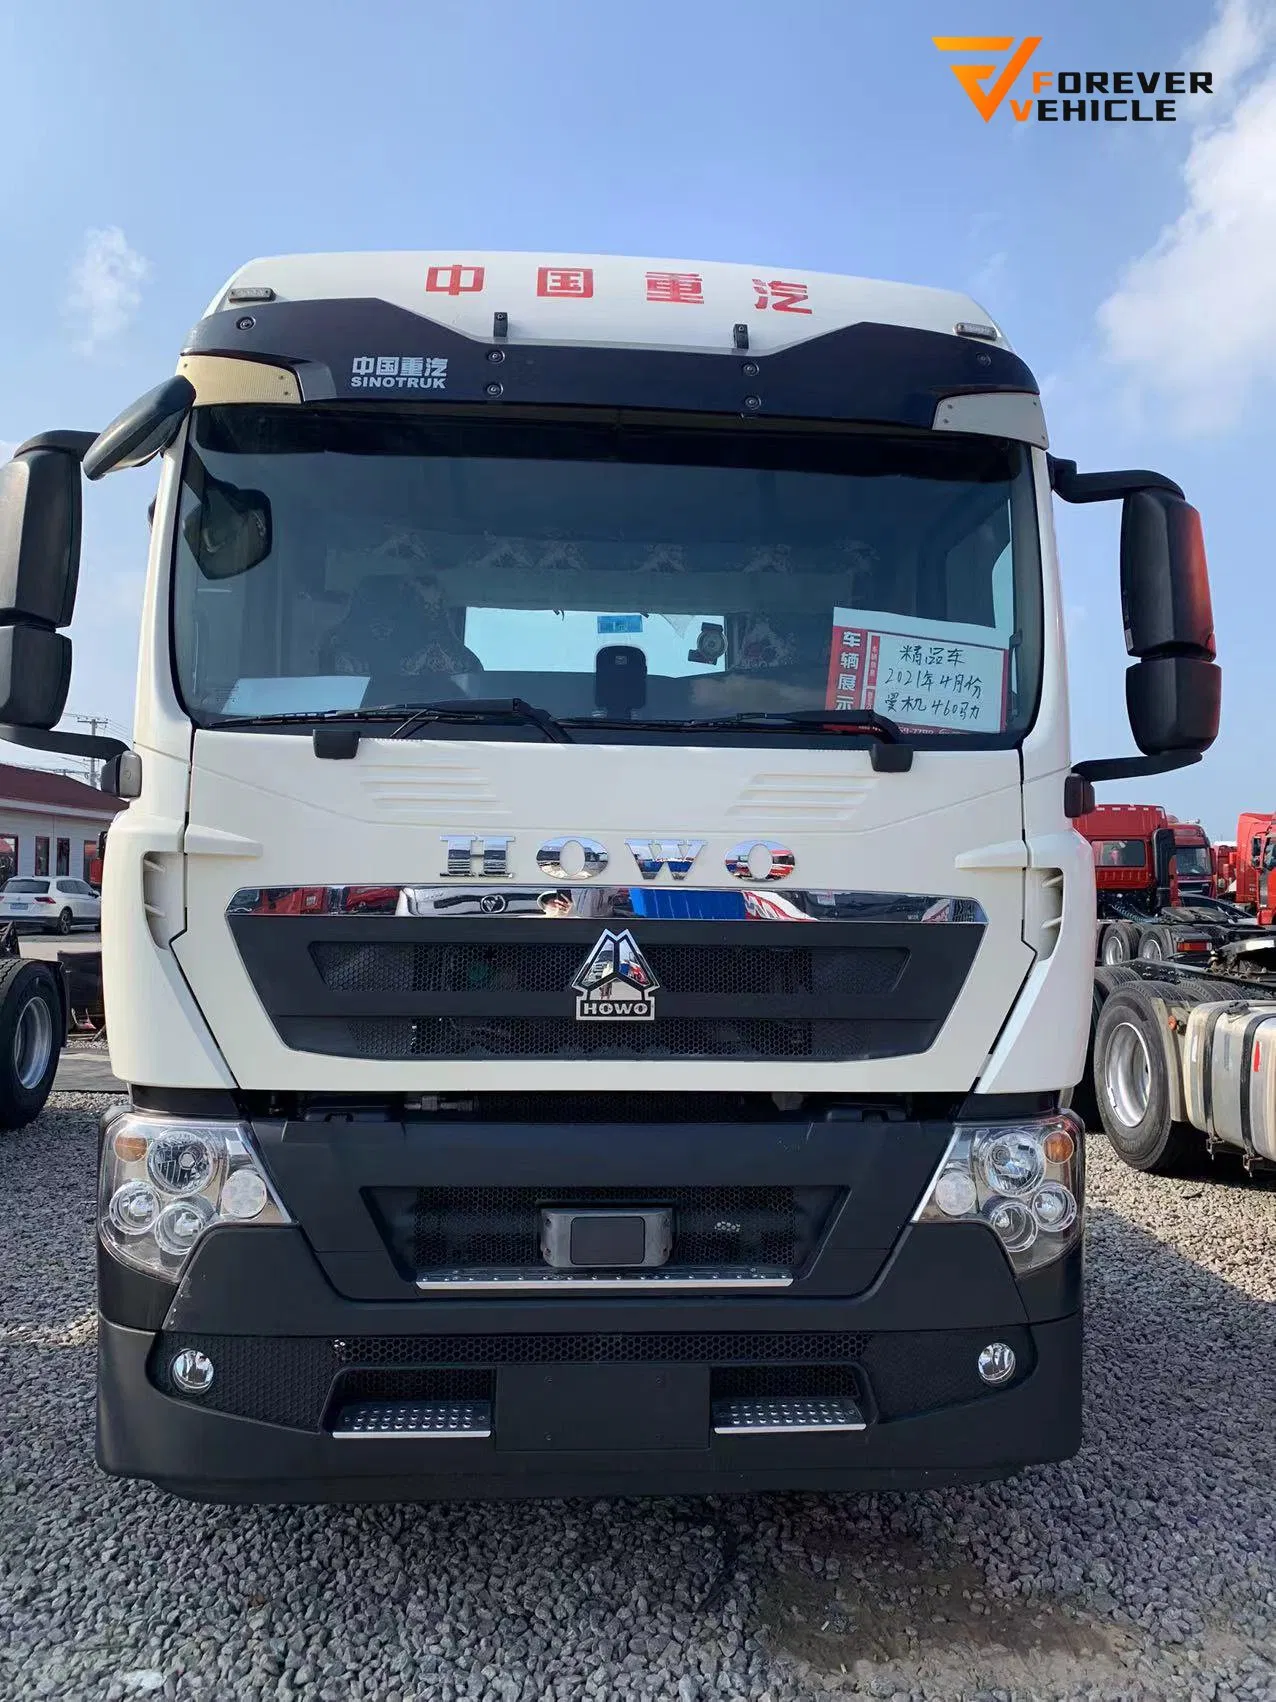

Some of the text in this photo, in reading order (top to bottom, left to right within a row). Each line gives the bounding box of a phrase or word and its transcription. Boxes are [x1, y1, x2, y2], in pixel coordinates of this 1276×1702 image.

[426, 264, 813, 315] 中国重汽
[352, 356, 448, 377] 中国重汽
[351, 376, 446, 389] SINOTRUK
[899, 645, 966, 666] 精品车
[835, 631, 862, 711] 车辆展示
[439, 834, 797, 881] HOWO
[583, 1002, 648, 1016] HOWO
